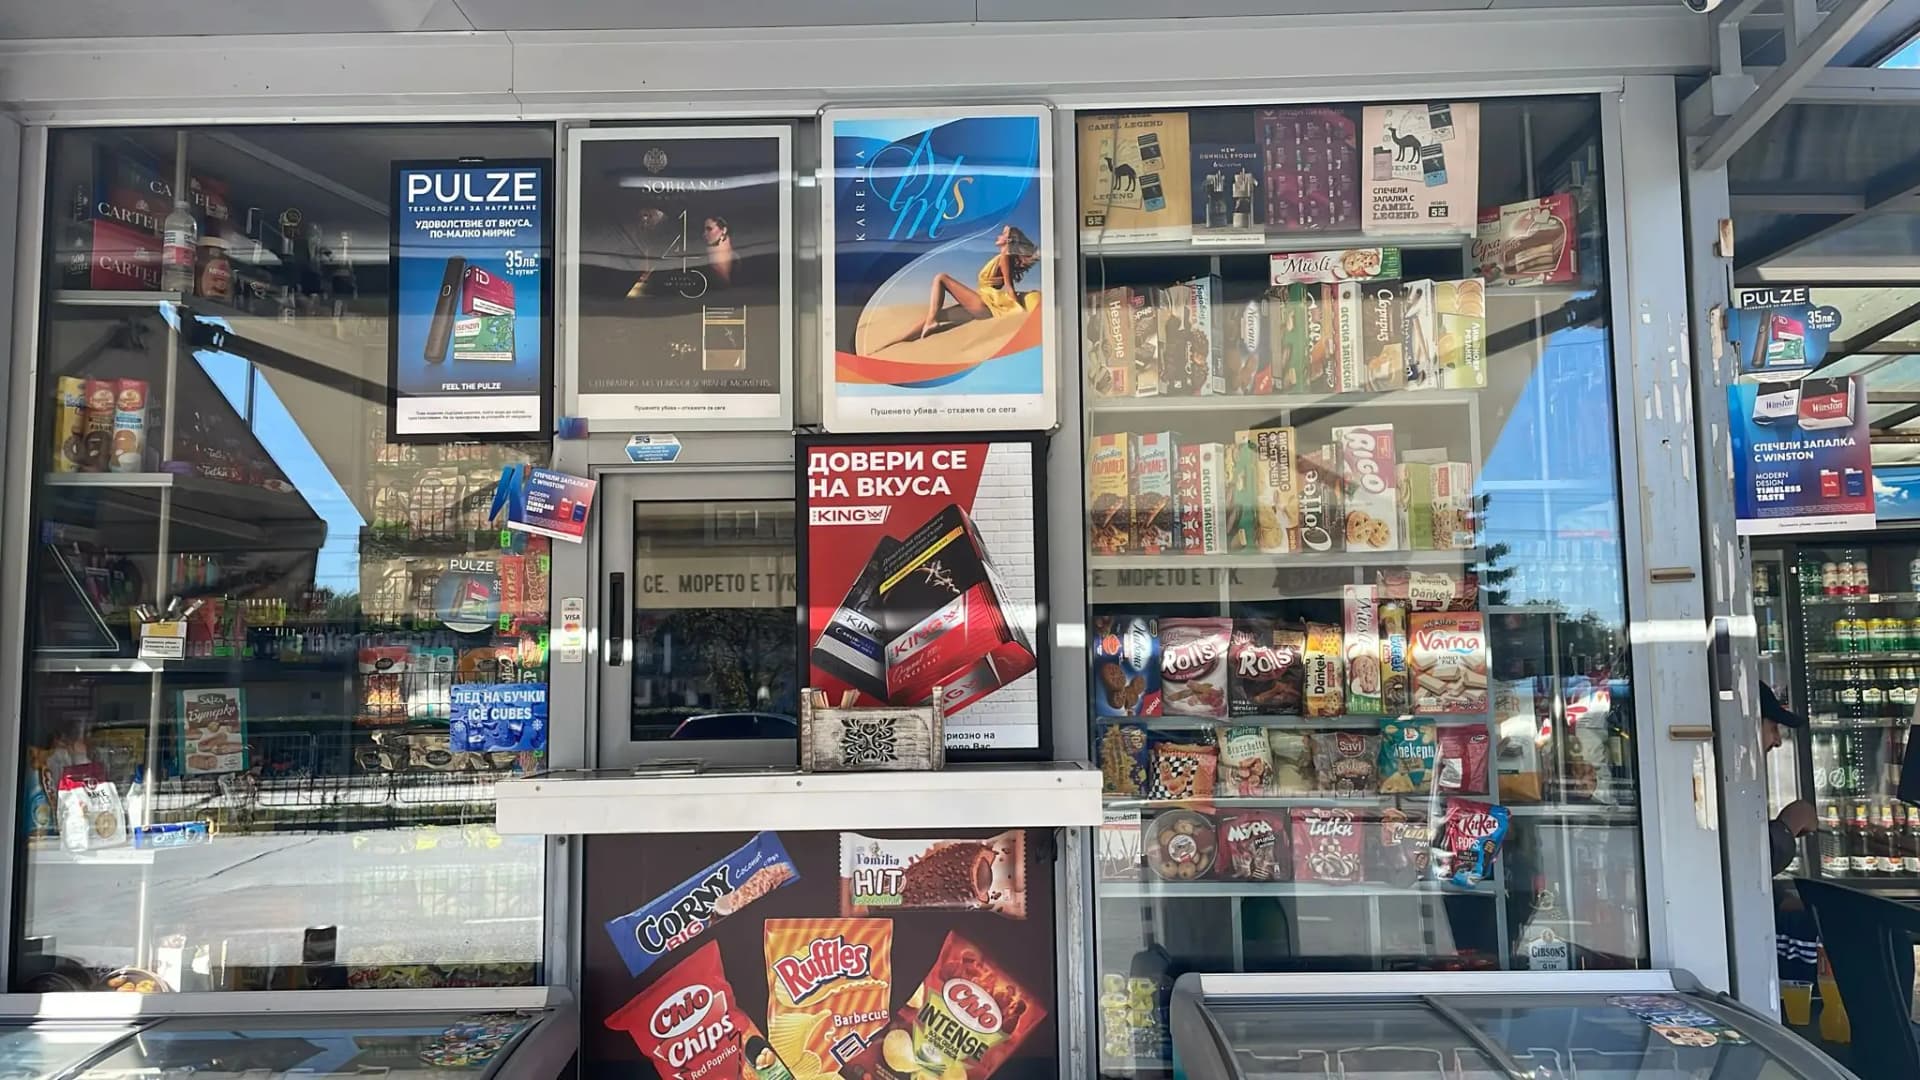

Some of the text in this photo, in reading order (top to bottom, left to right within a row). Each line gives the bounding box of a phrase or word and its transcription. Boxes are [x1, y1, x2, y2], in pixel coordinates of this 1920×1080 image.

[408, 172, 537, 203] PULZE
[856, 151, 865, 240] KARELIA
[1373, 195, 1408, 203] ЗАПАЛКА
[1373, 203, 1414, 211] CAMEL
[415, 220, 484, 229] УДОВОЛСТВИЕ
[485, 219, 498, 228] ОТ
[1373, 212, 1419, 220] LEGEND
[429, 228, 516, 239] ПО-МАЛКО МИРИС
[1282, 256, 1331, 275] Müsli
[1743, 288, 1805, 306] PULZE
[441, 383, 460, 391] FEEL
[477, 382, 501, 390] PULZE
[913, 408, 937, 416] убива
[1766, 400, 1794, 409] Winston
[1812, 402, 1843, 412] Winston
[1259, 433, 1268, 460] КРЕМ
[1753, 438, 1856, 452] СПЕЧЕЛИ ЗАПАЛКА
[808, 450, 968, 475] ДОВЕРИ СЕ
[1269, 432, 1279, 487] ФЪСТЪЧЕН
[1754, 451, 1814, 463] С WINSTON
[534, 471, 588, 488] СПЕЧЕЛИ ЗАПАЛКА
[1755, 472, 1788, 480] MODERN
[808, 476, 951, 498] НА ВКУСА
[1756, 485, 1802, 495] TIMELESS
[1756, 494, 1785, 502] TASTE
[817, 509, 866, 523] KING
[1203, 468, 1213, 552] ДЕТСКА ЗАКУСКА
[1299, 470, 1332, 550] Coffee
[450, 559, 494, 572] PULZE
[644, 574, 669, 593] СЕ.
[678, 574, 744, 592] МОРЕТО
[752, 574, 760, 591] Е
[1117, 569, 1186, 586] МОРЕТО
[1411, 588, 1452, 600] Dankek
[893, 617, 943, 657] KING
[1417, 631, 1480, 651] Varna
[1162, 643, 1217, 673] Rolls
[1238, 647, 1294, 676] Rolls
[1314, 654, 1325, 695] Dankek
[455, 689, 545, 704] ЛЕД НА БУЧКИ
[468, 707, 532, 721] ICE CUBES
[944, 733, 980, 741] риозно
[1462, 813, 1497, 836] KitKat
[1457, 836, 1480, 849] POPS
[854, 869, 904, 897] HIT
[636, 864, 735, 954] CORNY
[665, 920, 704, 951] BIG
[773, 935, 871, 1004] Ruffles
[654, 988, 710, 1034] Chio
[948, 984, 998, 1029] Chio
[834, 1010, 888, 1027] Barbecue
[668, 1014, 734, 1068] Chips
[918, 1002, 989, 1062] INTENSE
[690, 1044, 738, 1080] Red Paprika
